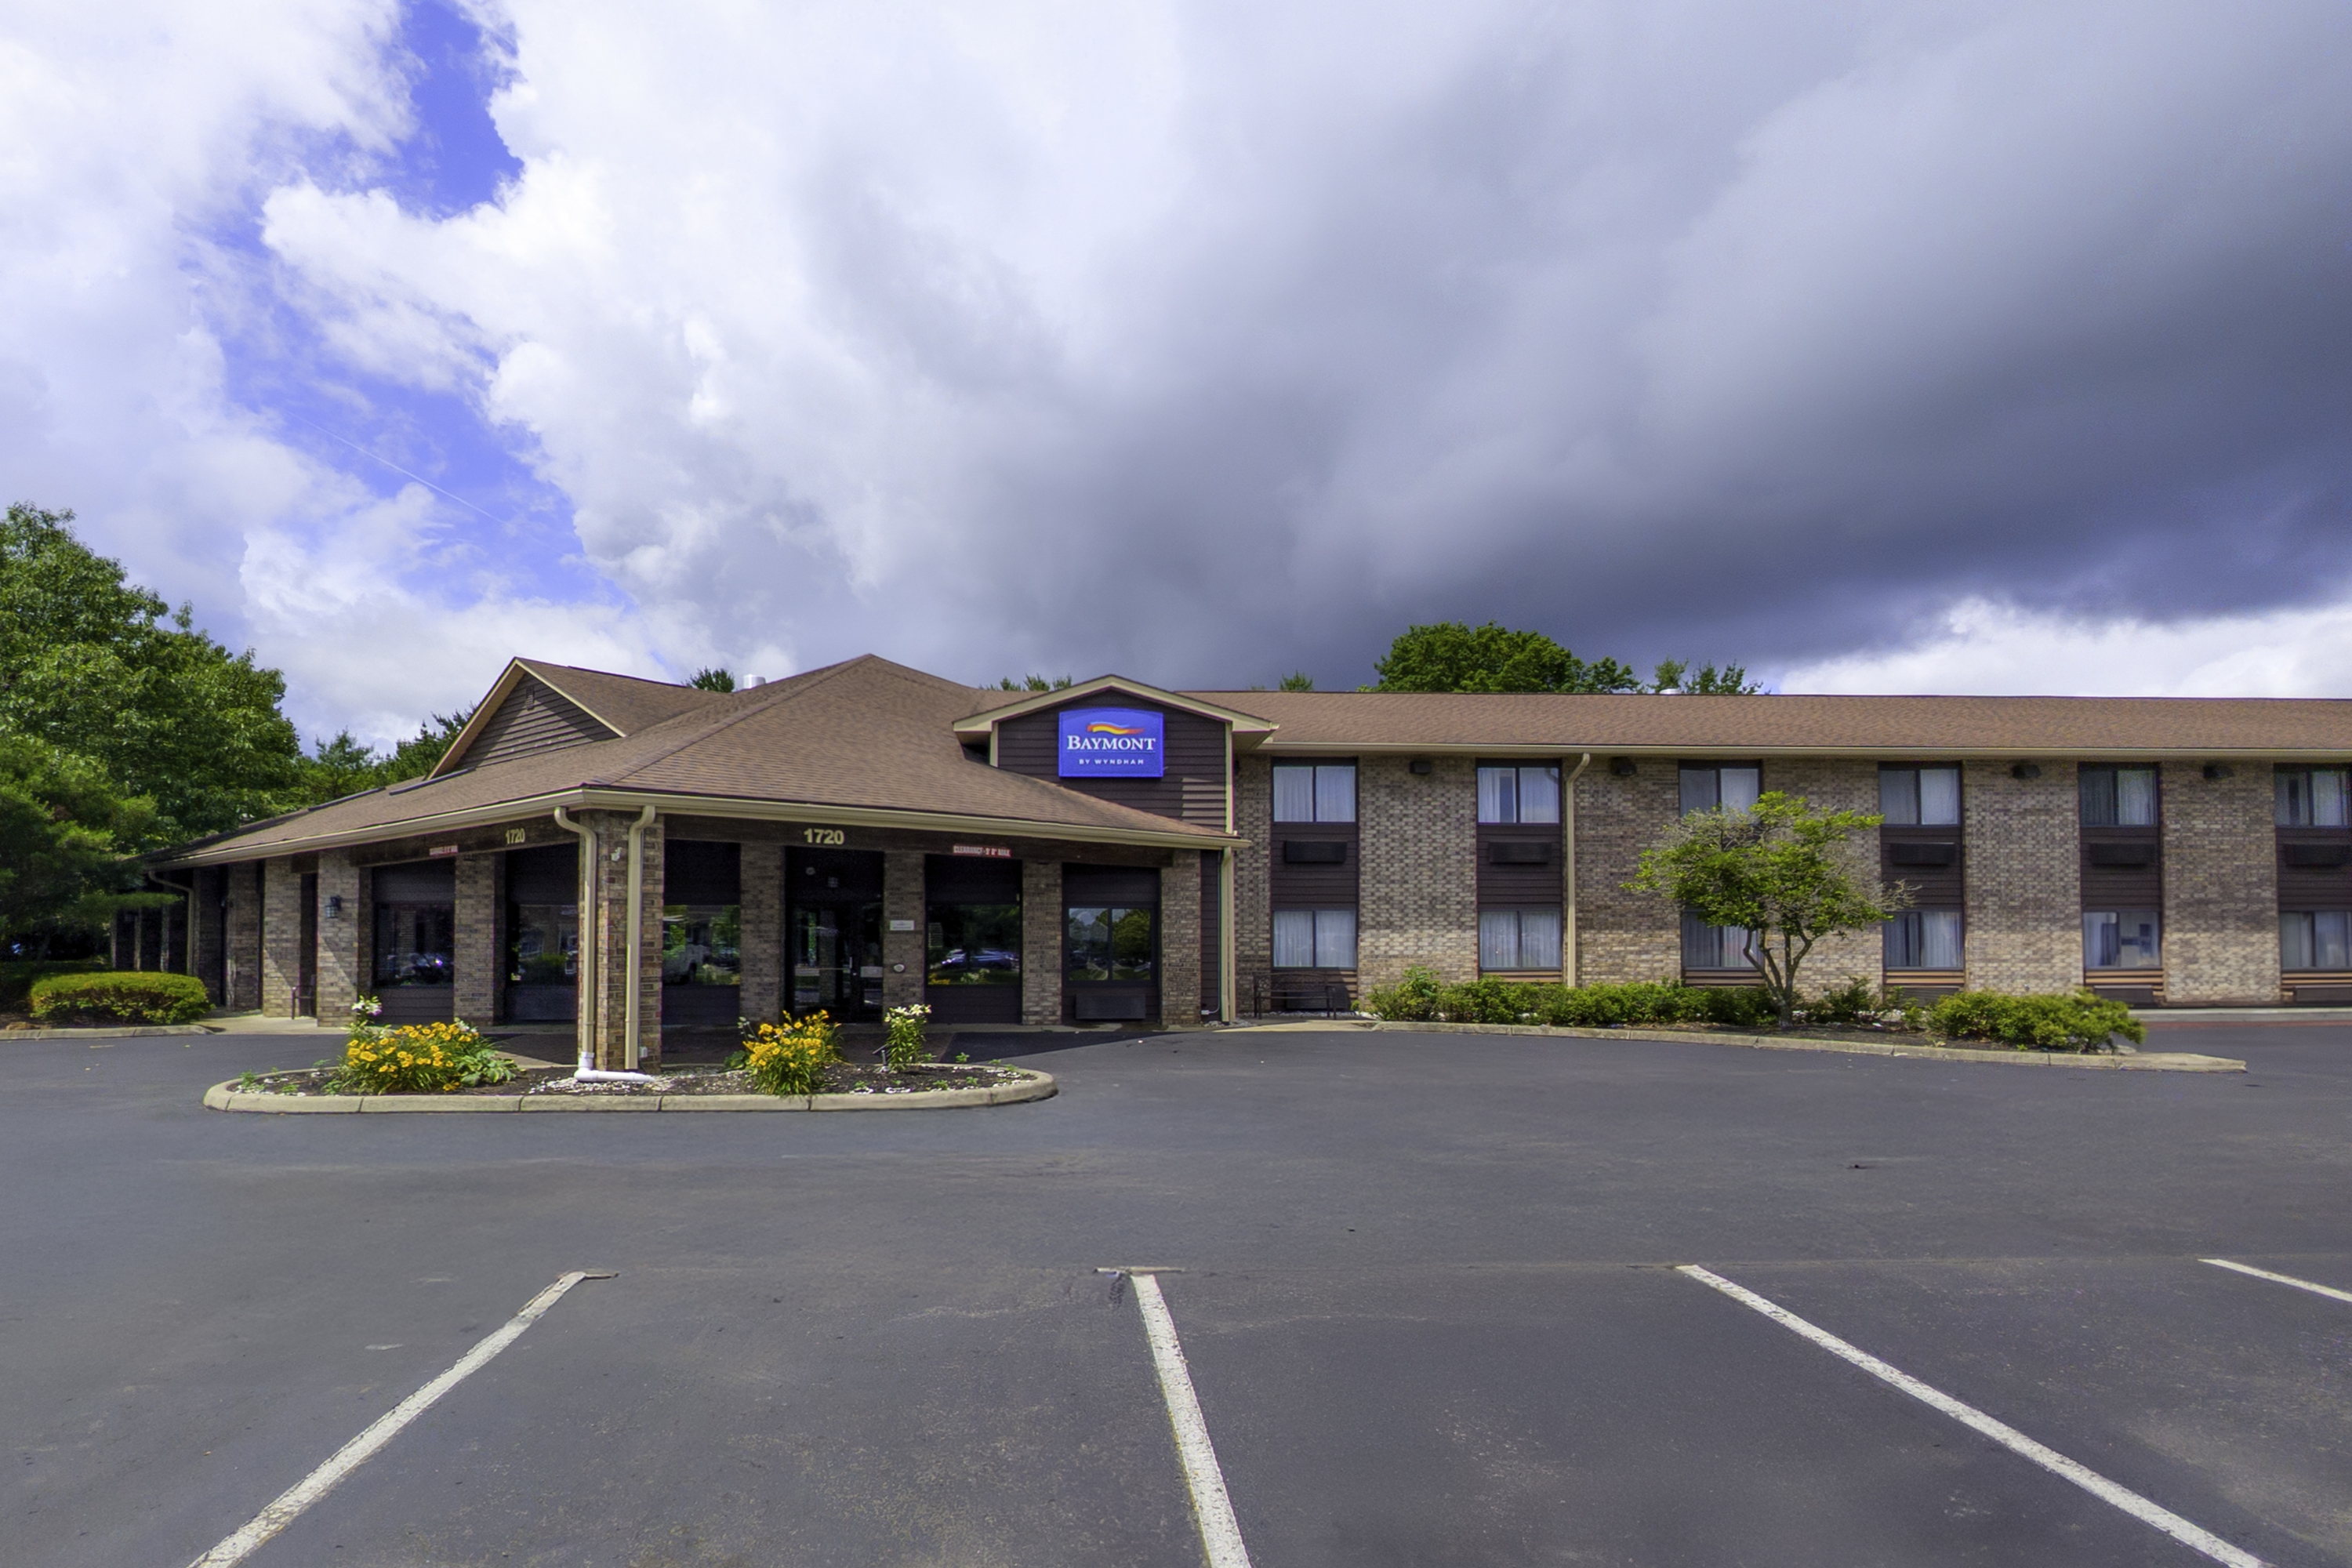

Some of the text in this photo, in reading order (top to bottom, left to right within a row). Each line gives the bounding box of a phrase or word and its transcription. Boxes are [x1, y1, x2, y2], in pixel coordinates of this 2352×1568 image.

[1067, 735, 1156, 750] BAYMONT
[505, 827, 526, 844] 1720
[804, 828, 845, 845] 1720
